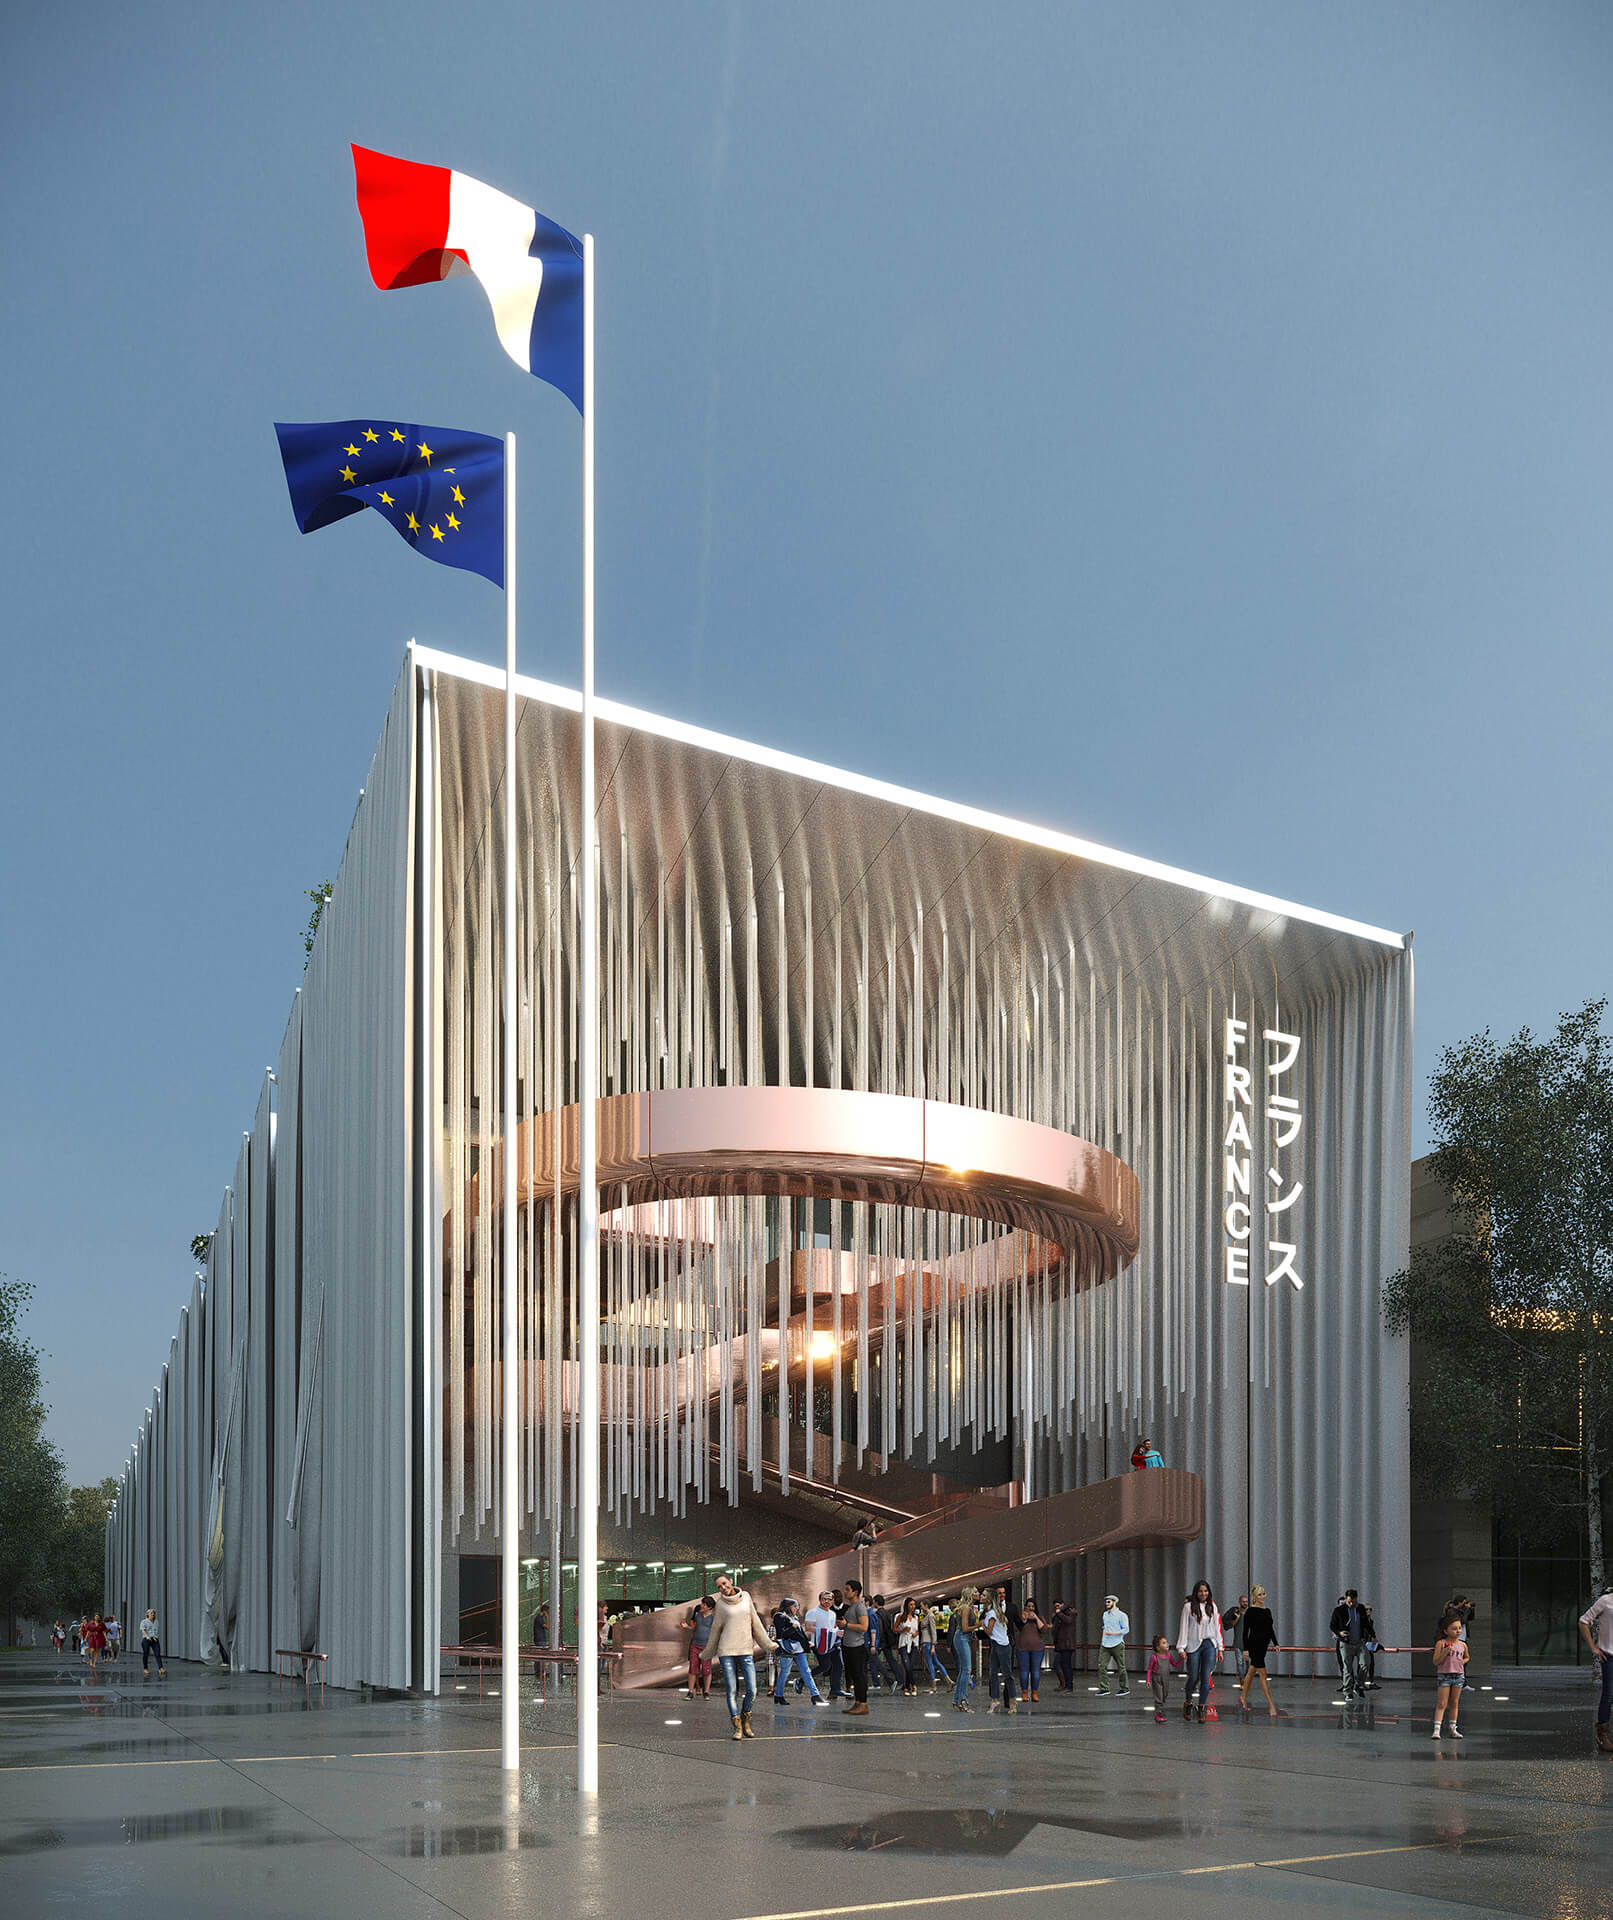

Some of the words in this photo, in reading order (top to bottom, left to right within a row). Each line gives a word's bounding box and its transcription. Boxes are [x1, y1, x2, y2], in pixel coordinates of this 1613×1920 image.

[1224, 1018, 1252, 1285] FRANCE
[1263, 1029, 1304, 1290] フランス
